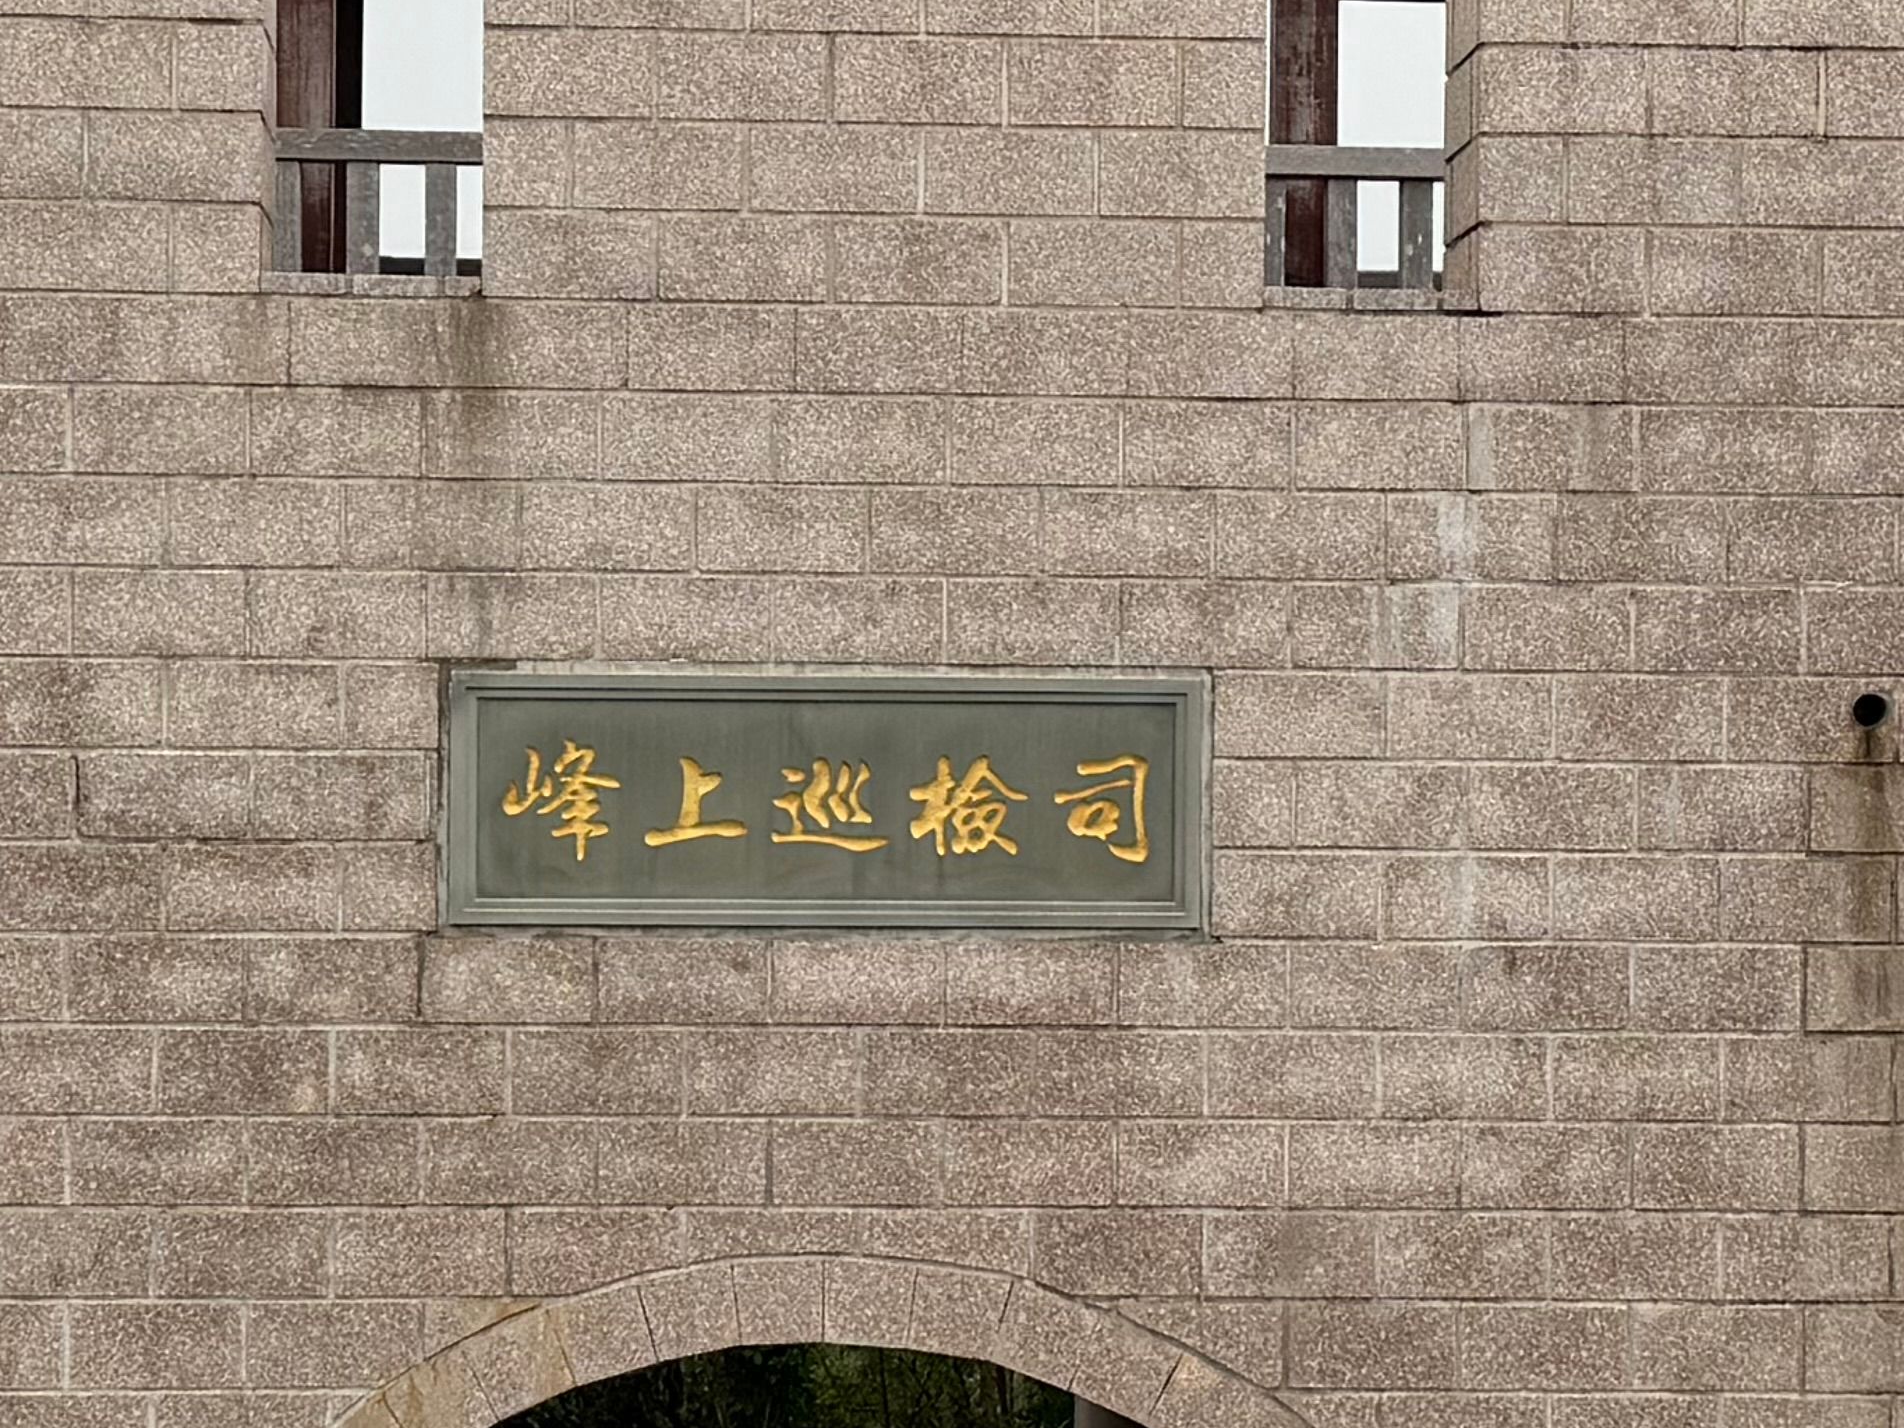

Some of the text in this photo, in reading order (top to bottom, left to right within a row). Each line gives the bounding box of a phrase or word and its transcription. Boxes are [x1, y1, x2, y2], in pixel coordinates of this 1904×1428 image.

[501, 739, 1151, 865] 峰上巡檢司
